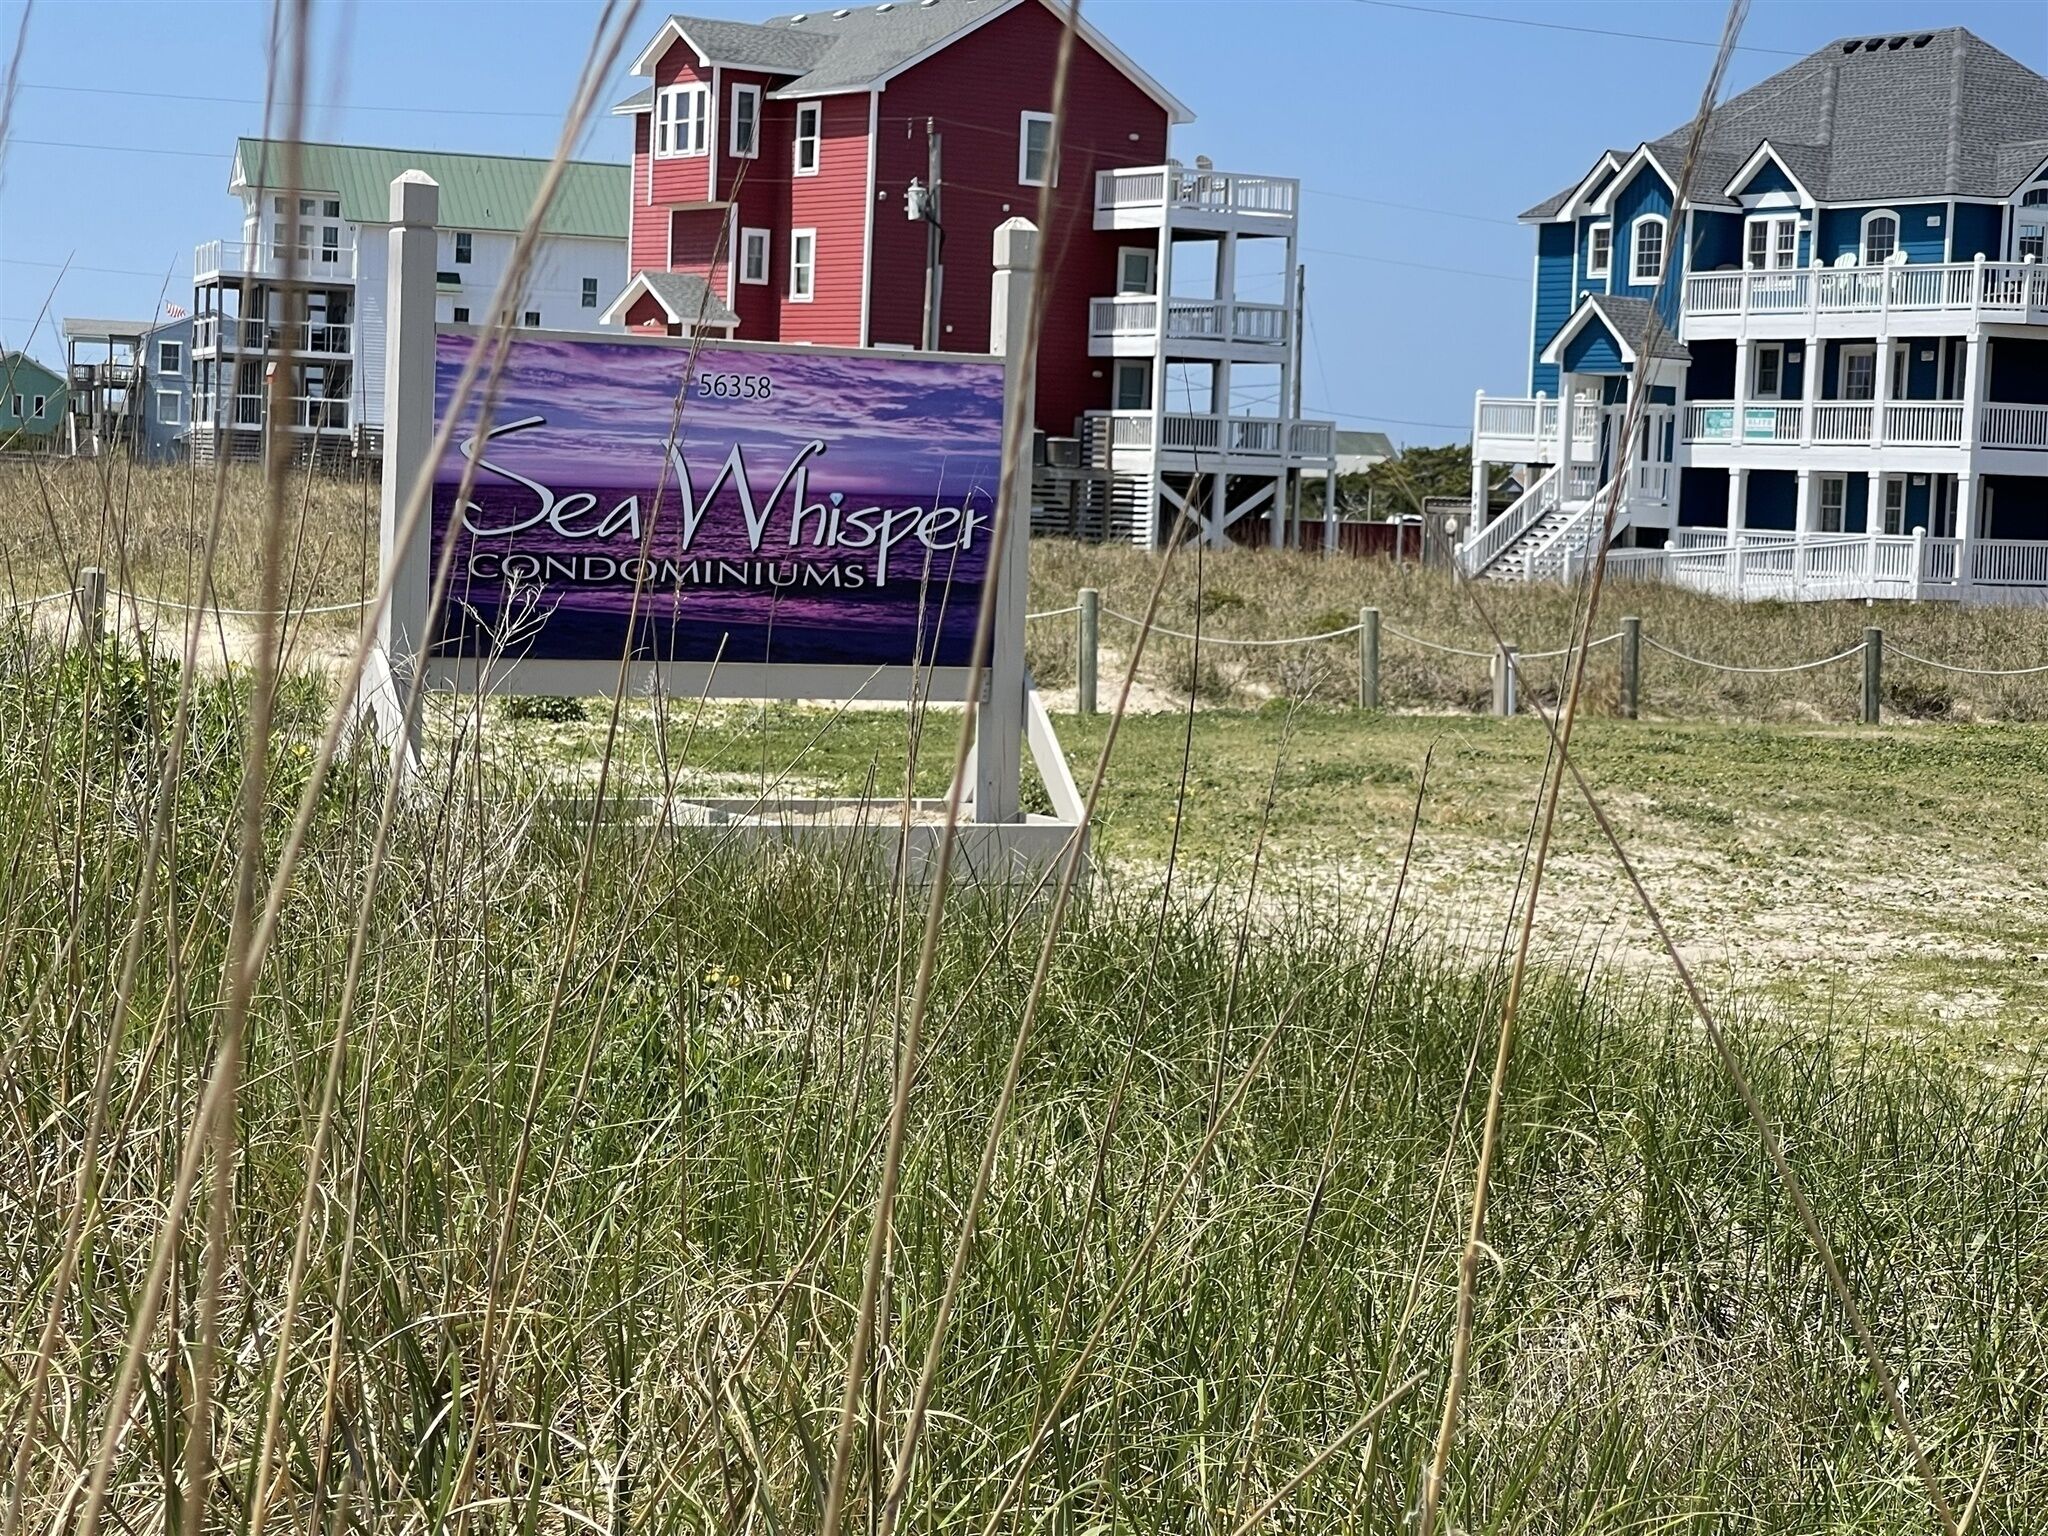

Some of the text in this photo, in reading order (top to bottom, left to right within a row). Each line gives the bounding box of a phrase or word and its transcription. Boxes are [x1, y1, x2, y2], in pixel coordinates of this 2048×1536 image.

[699, 373, 771, 398] 56358
[456, 415, 988, 587] Sea Whisper
[469, 553, 865, 589] CONDOMINIUMS
